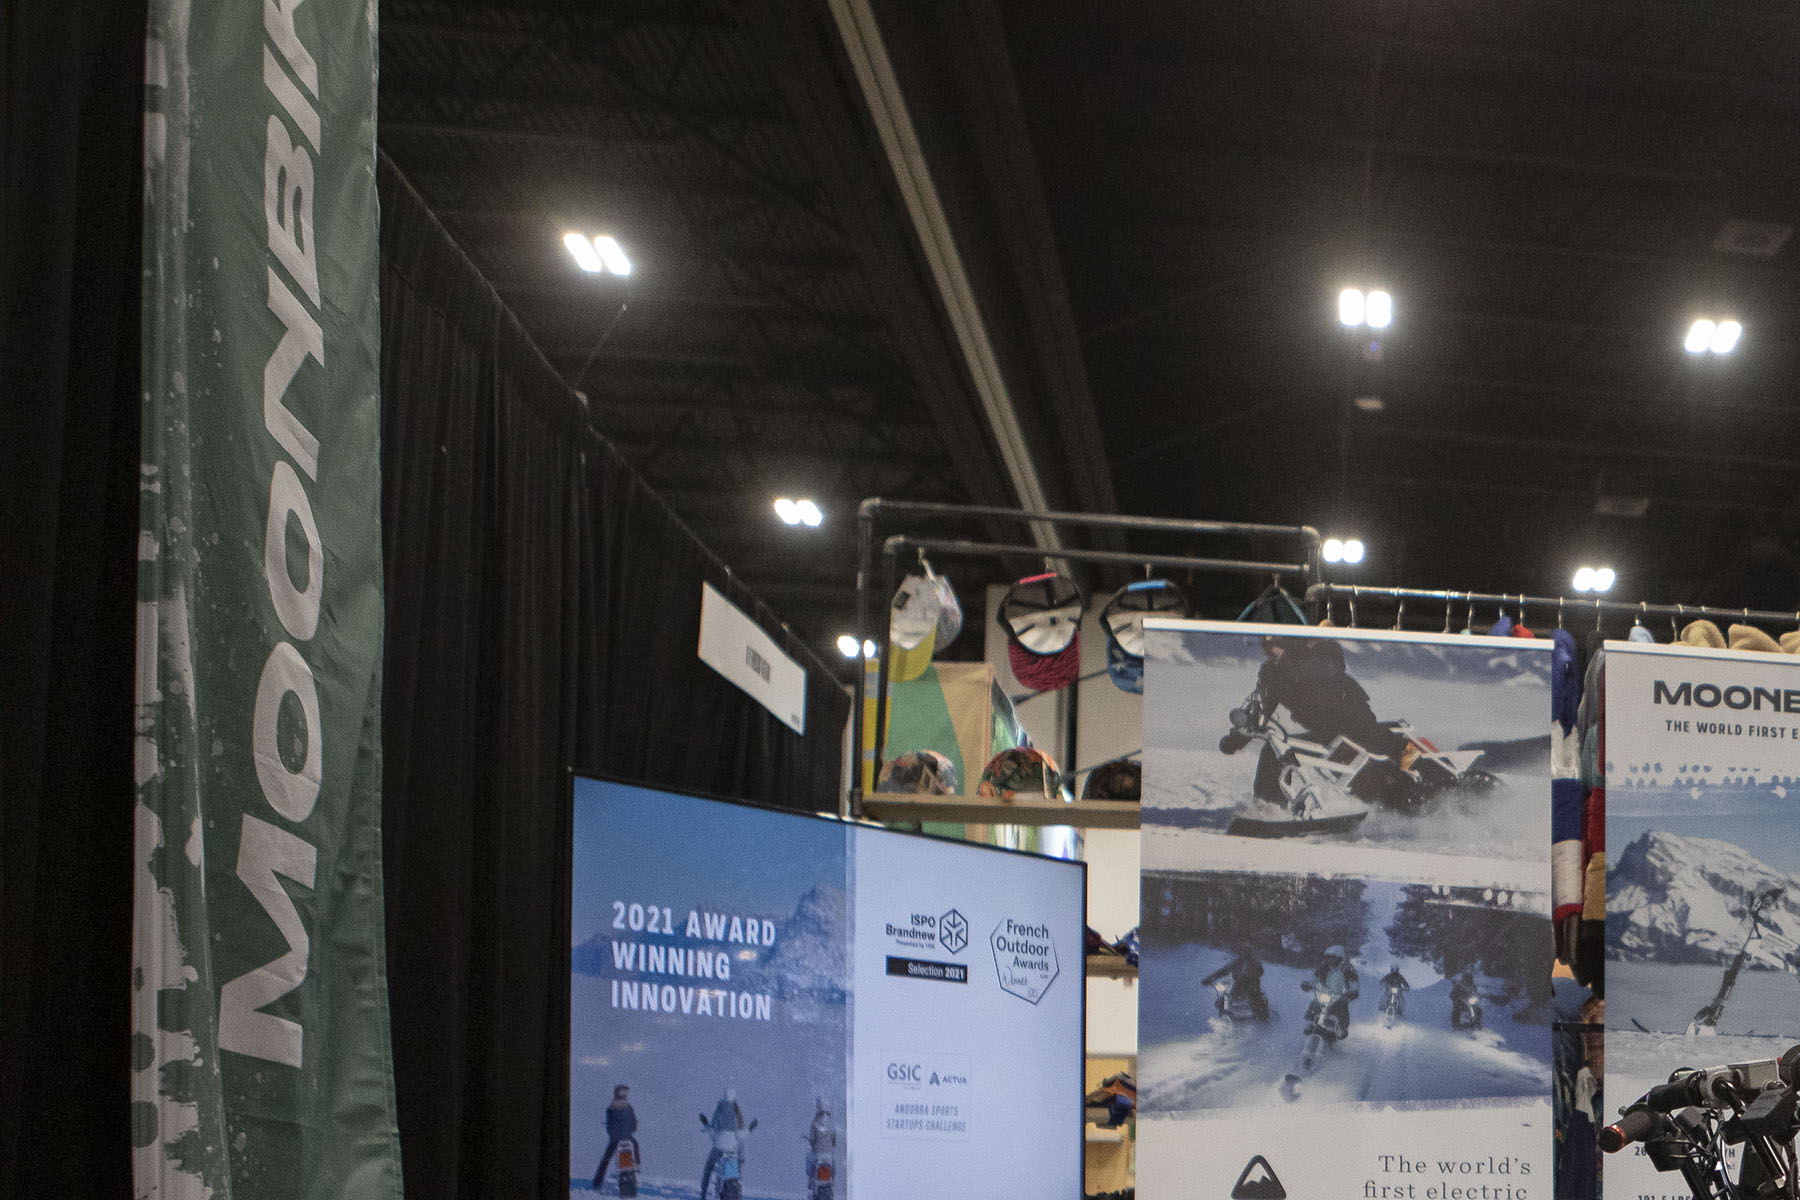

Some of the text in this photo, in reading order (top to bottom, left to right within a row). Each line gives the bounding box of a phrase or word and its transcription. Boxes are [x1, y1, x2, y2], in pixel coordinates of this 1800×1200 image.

[1665, 719, 1690, 733] THE
[1696, 721, 1743, 736] WORLD
[1749, 725, 1786, 739] FIRST
[612, 901, 776, 946] 2021 AWARD
[910, 914, 936, 929] ISPO
[1006, 919, 1049, 938] French
[886, 923, 936, 941] Brandnew
[996, 935, 1049, 956] Outdoor
[611, 940, 731, 981] WINNING
[1012, 956, 1049, 971] Awards
[907, 962, 965, 981] Selection 2021
[611, 980, 771, 1021] INNOVATION
[887, 1062, 921, 1081] GSIC
[1378, 1155, 1532, 1175] The world's
[1363, 1180, 1528, 1200] first electric
